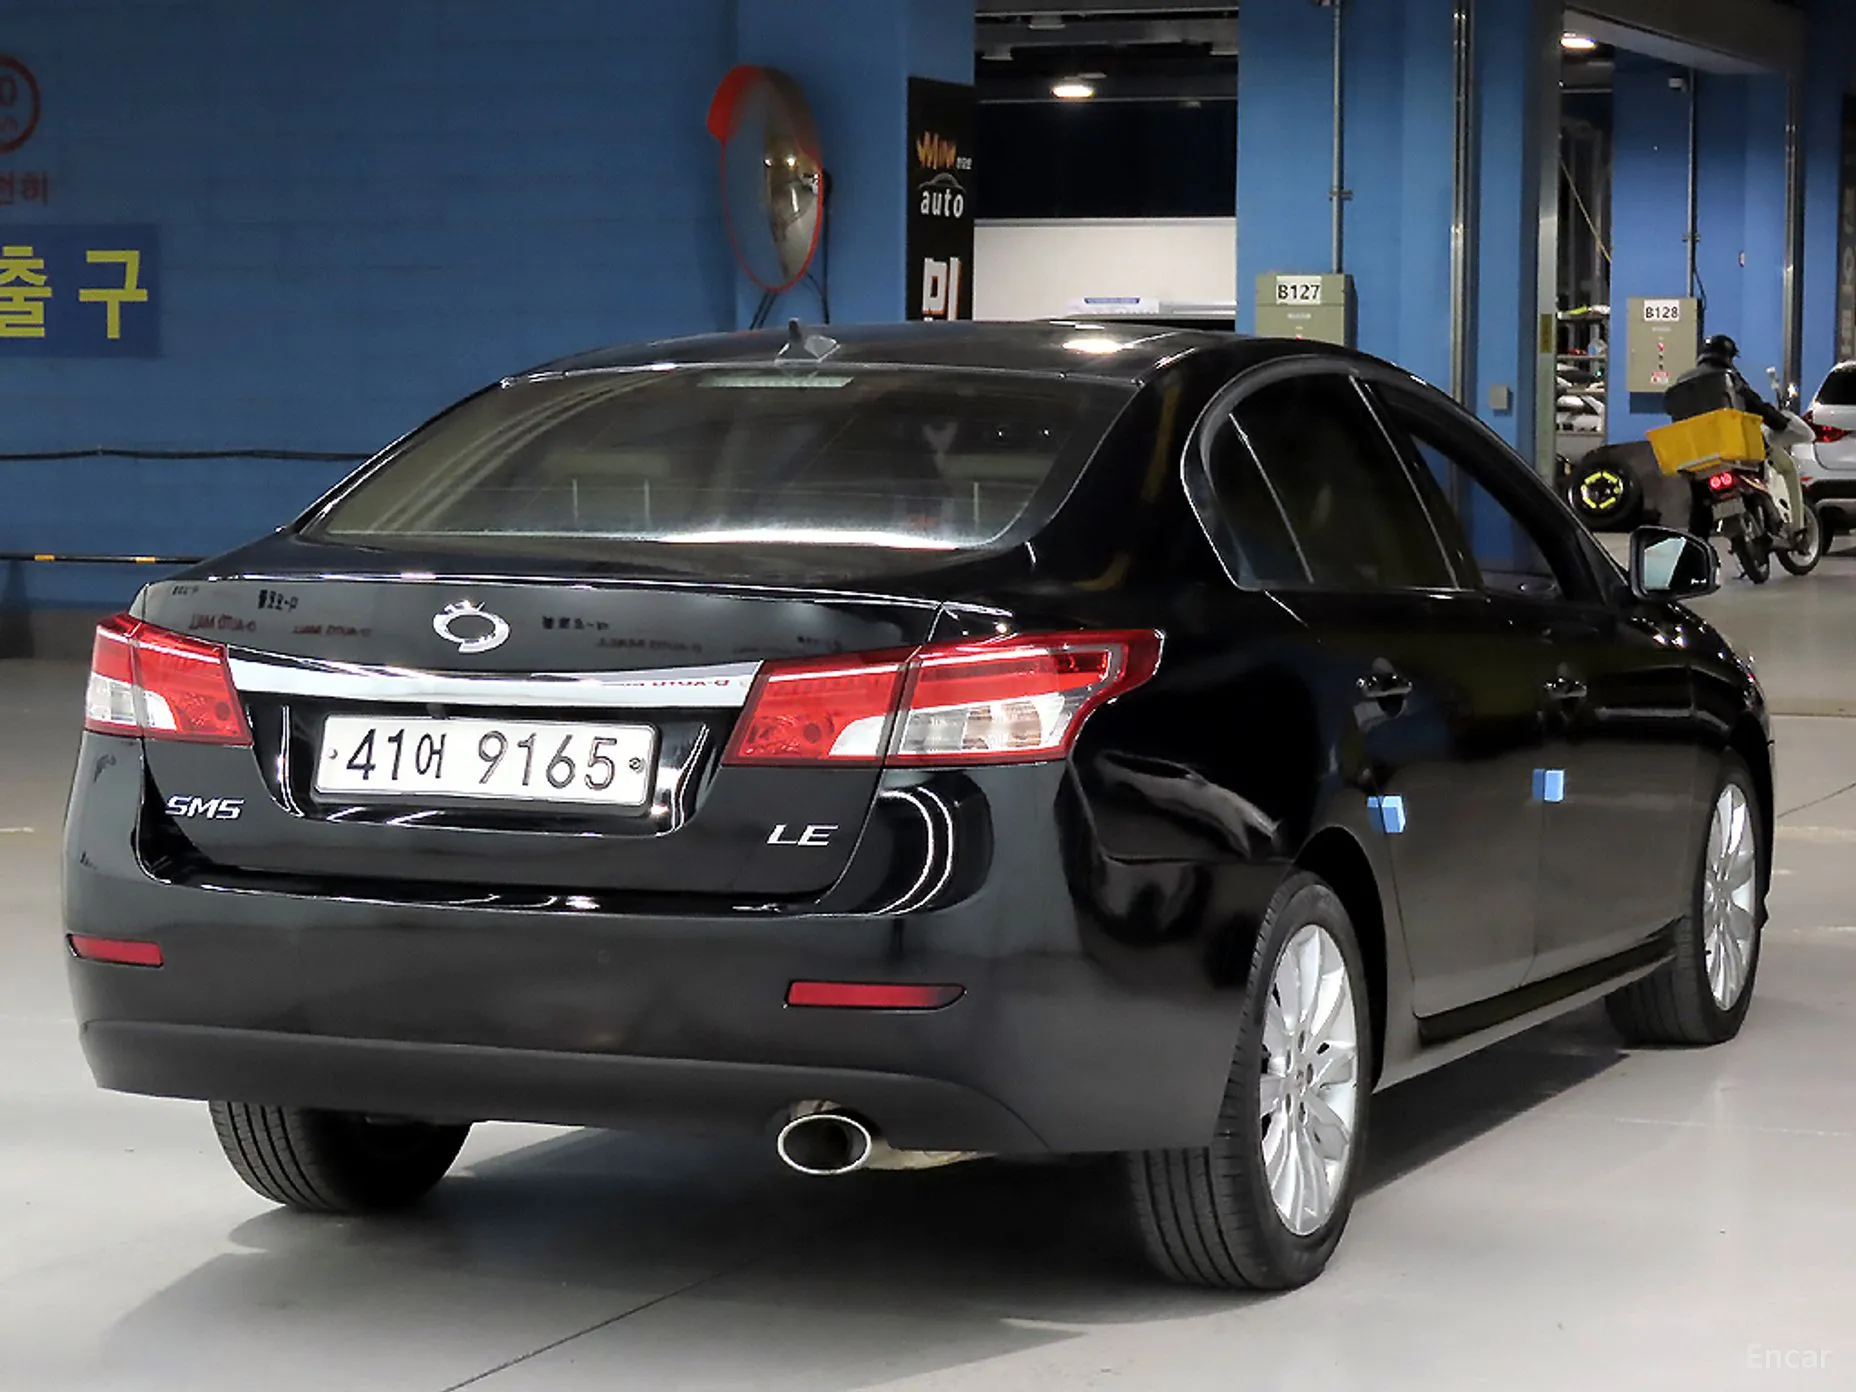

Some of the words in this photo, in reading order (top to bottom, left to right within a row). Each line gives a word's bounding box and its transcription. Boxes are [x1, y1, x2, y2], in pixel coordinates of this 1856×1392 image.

[920, 189, 965, 218] auto
[1278, 284, 1320, 300] B127
[1645, 306, 1679, 319] B128
[346, 728, 447, 781] 41어
[477, 730, 618, 790] 9165
[165, 795, 244, 819] SM5
[766, 824, 839, 846] LE
